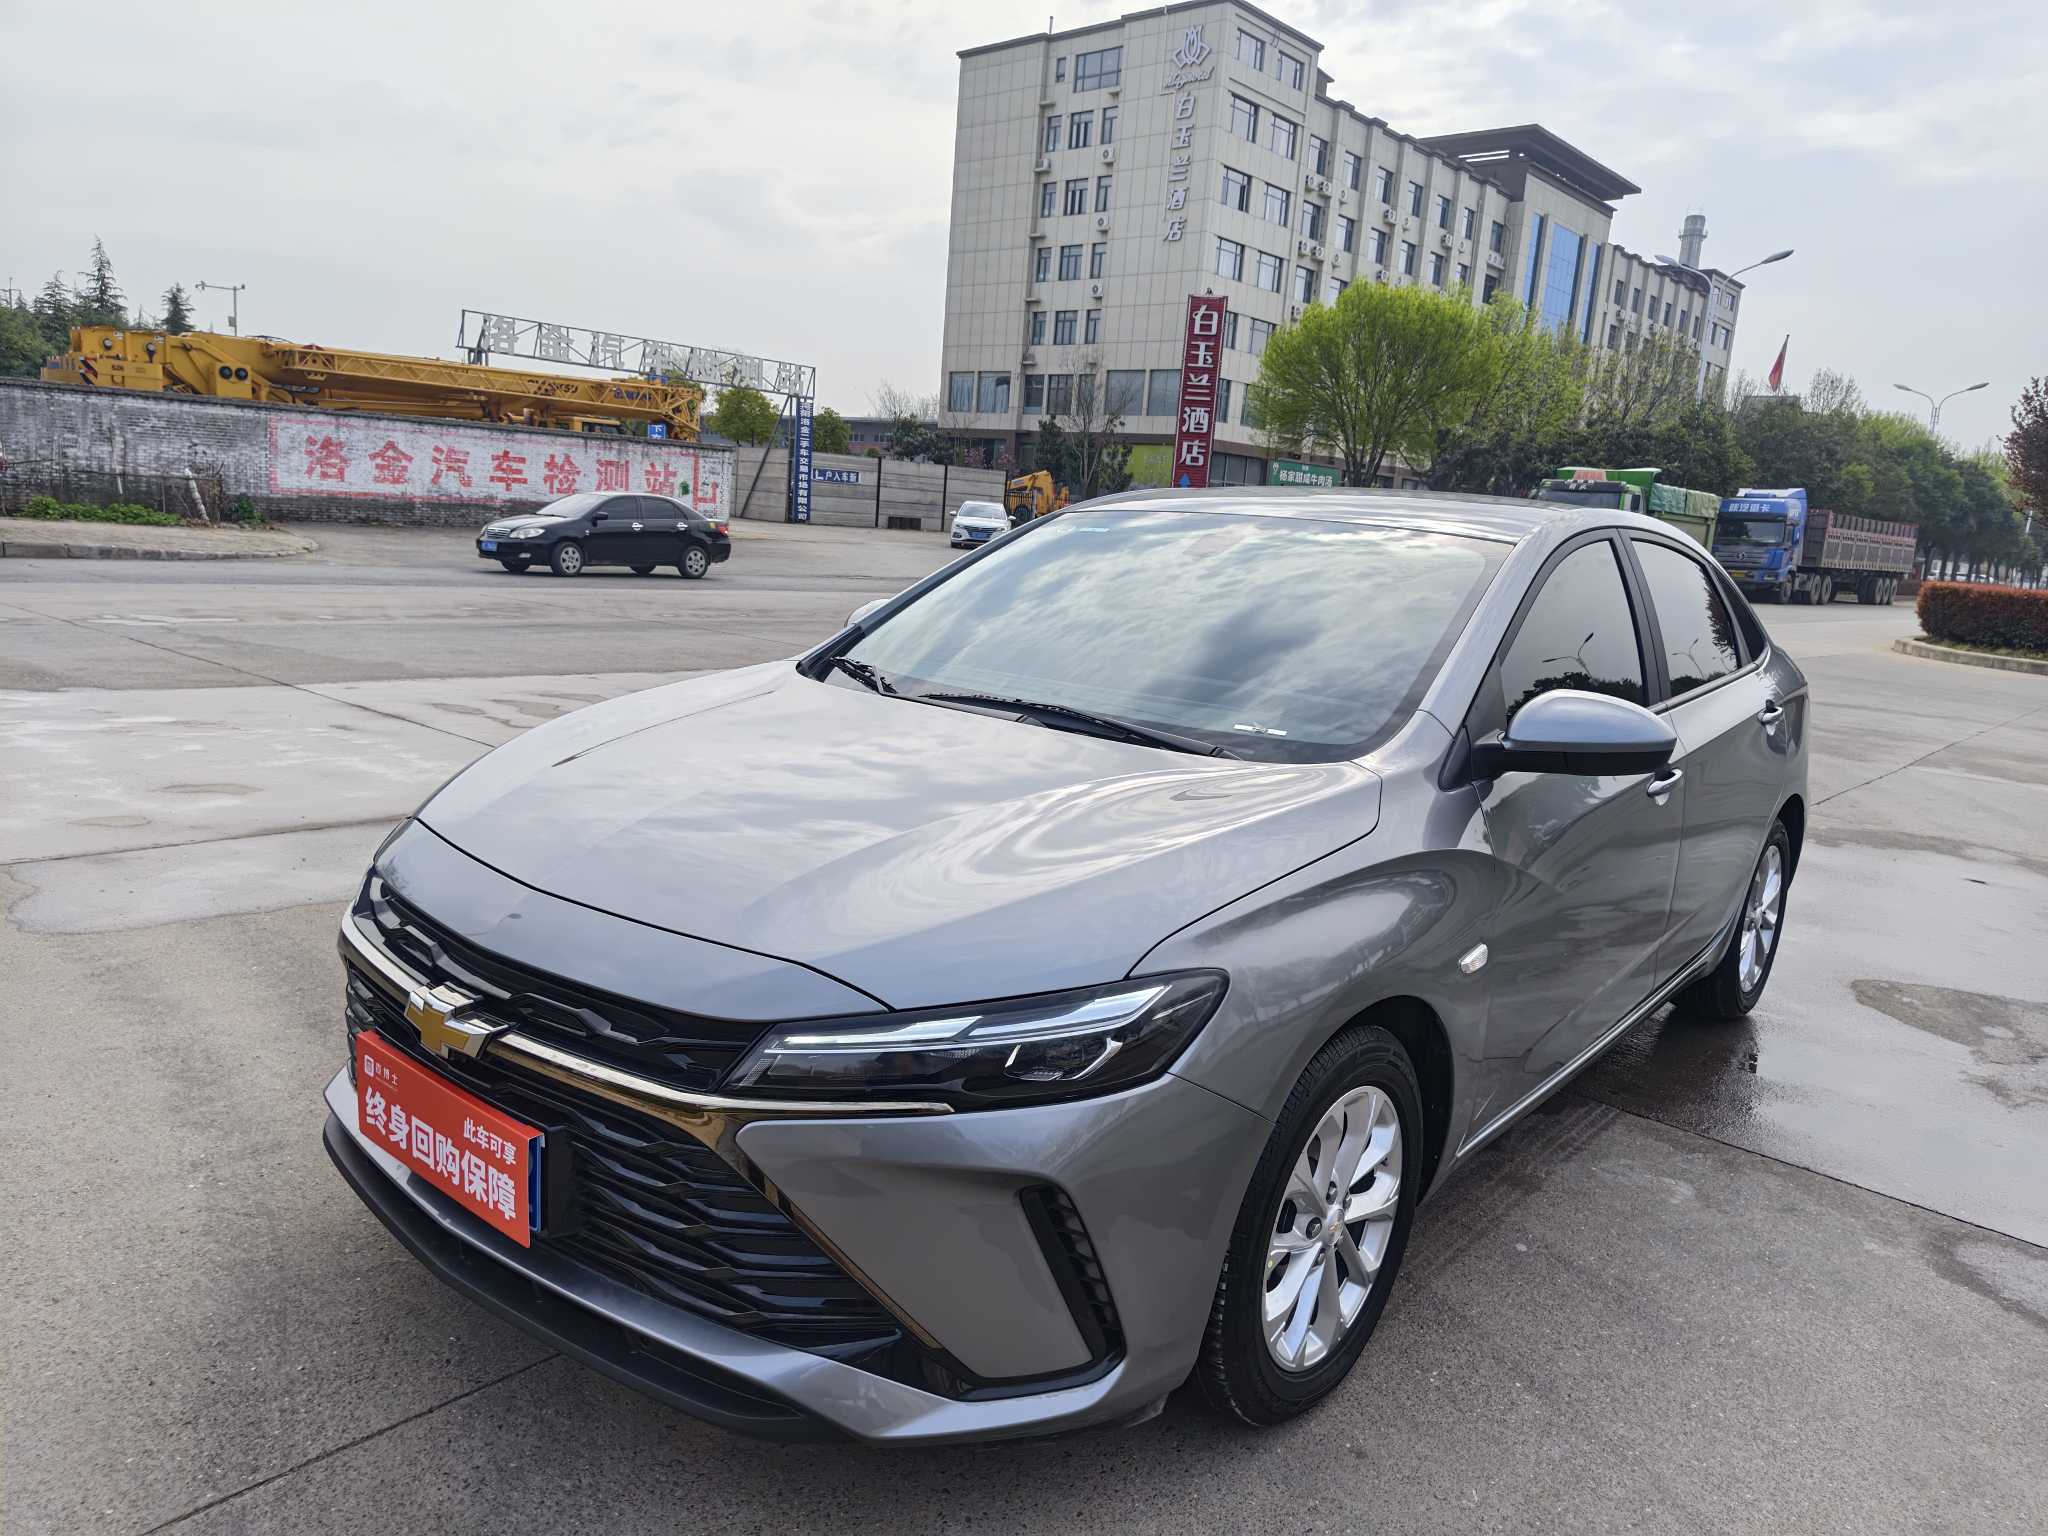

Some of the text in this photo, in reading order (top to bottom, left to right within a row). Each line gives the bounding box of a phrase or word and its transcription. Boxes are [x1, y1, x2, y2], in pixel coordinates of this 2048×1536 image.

[1164, 91, 1196, 242] 白玉兰酒店
[1179, 304, 1219, 466] 白玉兰酒店
[303, 435, 678, 494] 洛金汽车检测站
[365, 1086, 516, 1220] 终身回购保障
[464, 1117, 516, 1166] 此车可享
